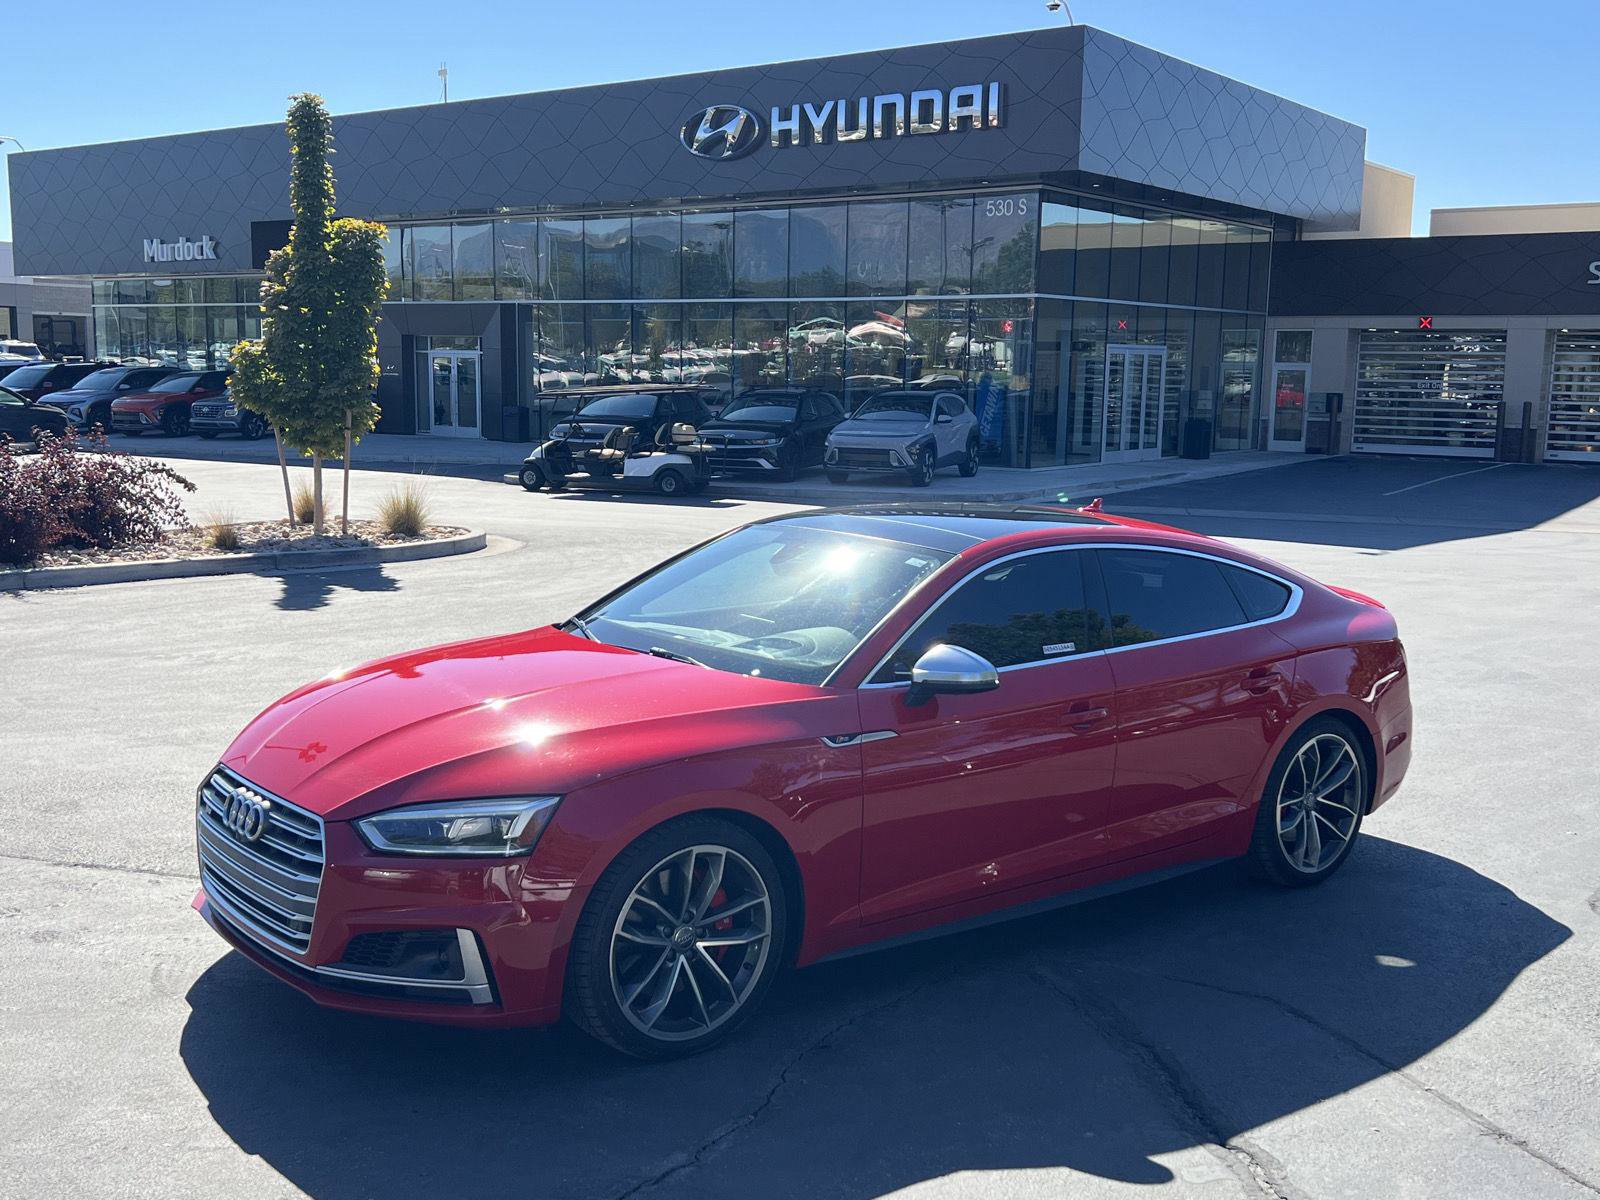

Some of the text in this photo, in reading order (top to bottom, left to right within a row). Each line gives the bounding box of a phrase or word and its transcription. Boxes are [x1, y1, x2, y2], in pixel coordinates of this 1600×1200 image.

[771, 81, 1000, 147] HYUNDAI
[986, 198, 1027, 217] 530 S
[143, 235, 217, 263] Murdock
